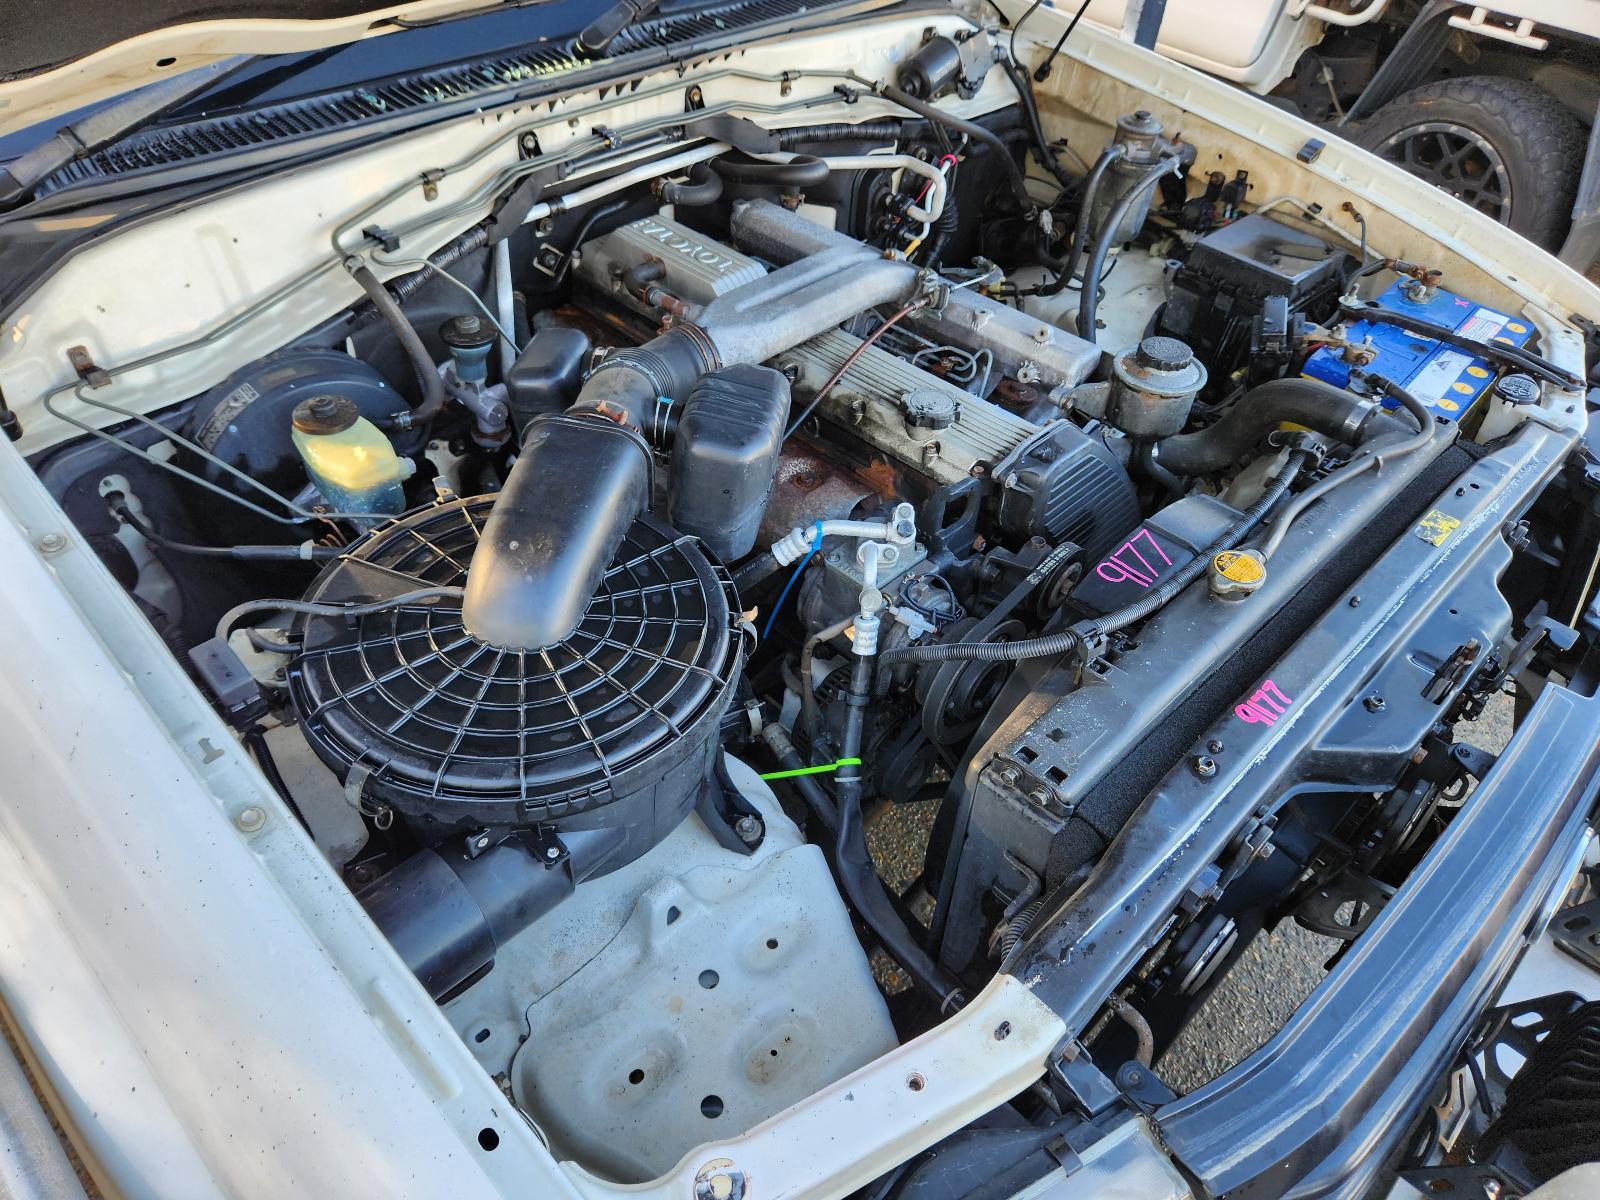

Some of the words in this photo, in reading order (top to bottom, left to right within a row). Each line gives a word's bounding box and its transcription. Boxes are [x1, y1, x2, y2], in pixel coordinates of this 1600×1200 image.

[641, 221, 733, 273] TOYOTA
[1096, 528, 1173, 587] 9177
[1234, 679, 1292, 727] 9177
